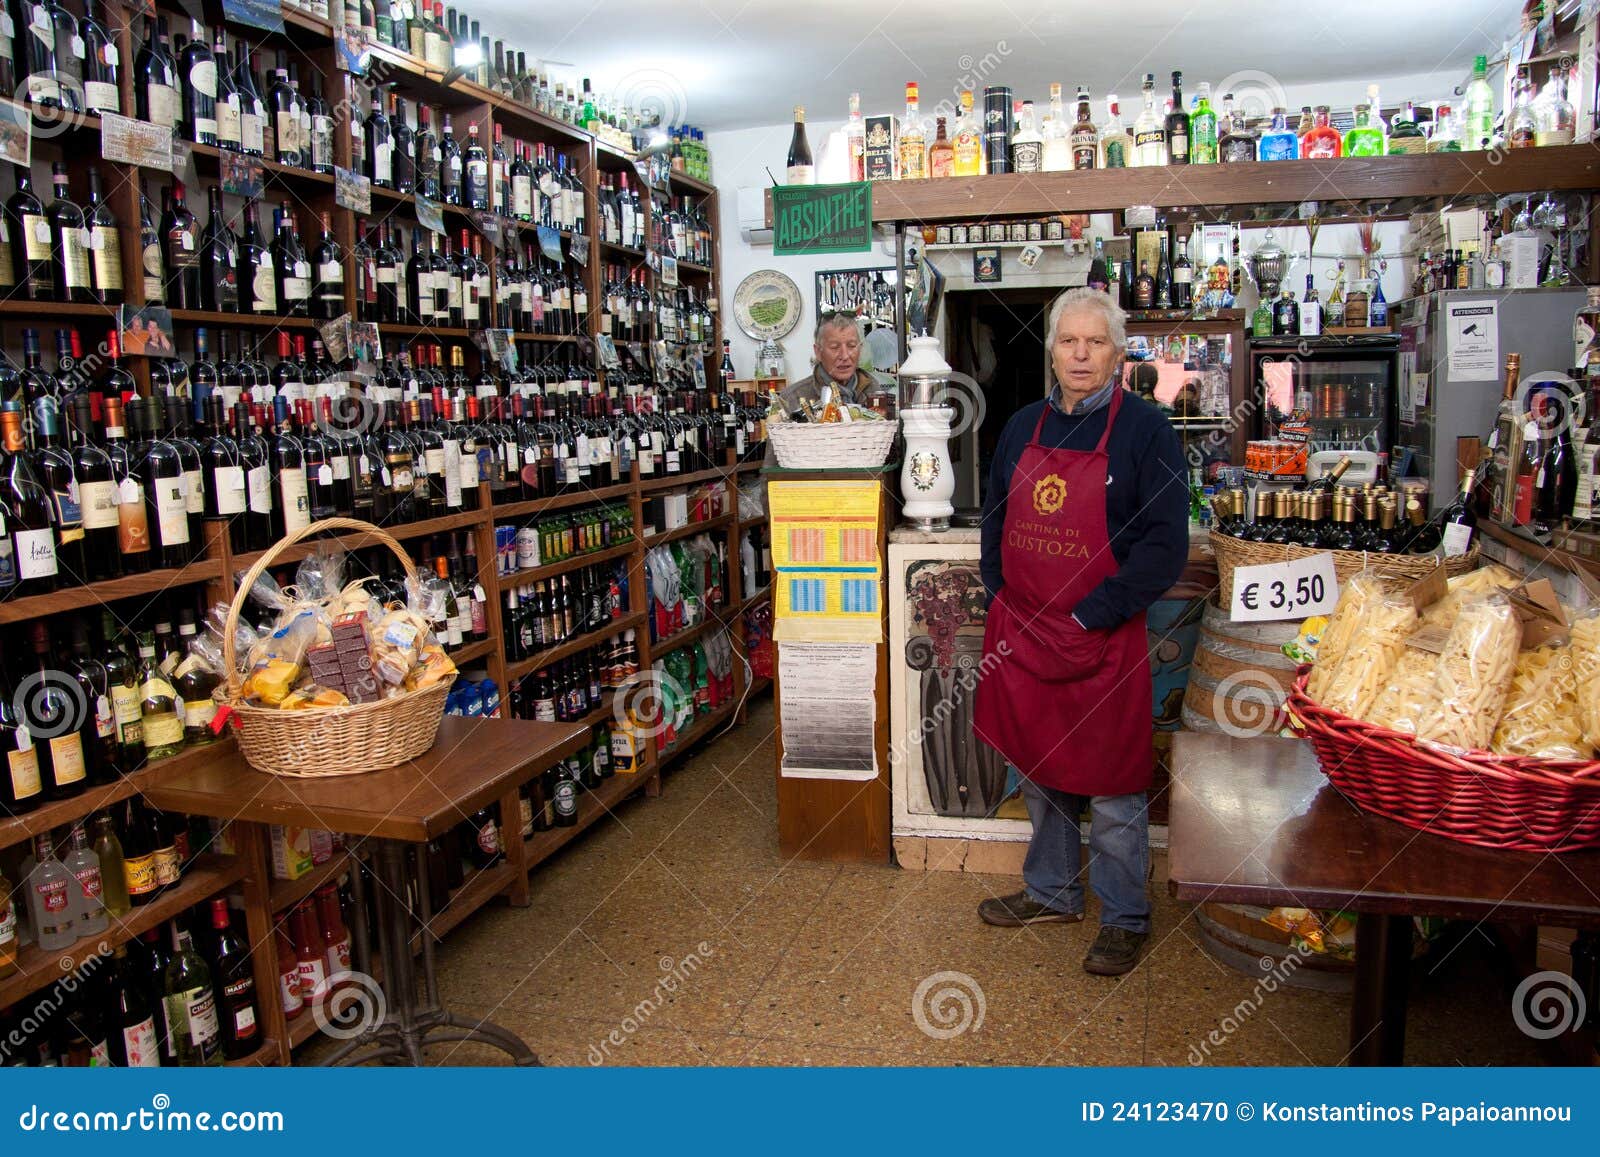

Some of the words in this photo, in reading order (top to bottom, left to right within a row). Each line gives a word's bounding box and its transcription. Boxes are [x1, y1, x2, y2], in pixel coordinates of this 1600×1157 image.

[1136, 131, 1164, 145] APEROL
[779, 187, 865, 247] ABSINTHE
[1015, 519, 1060, 536] CANTINA
[1065, 528, 1079, 537] DI
[1008, 530, 1090, 559] CUSTOZA
[1240, 583, 1260, 610] €
[1269, 573, 1325, 612] 3,50
